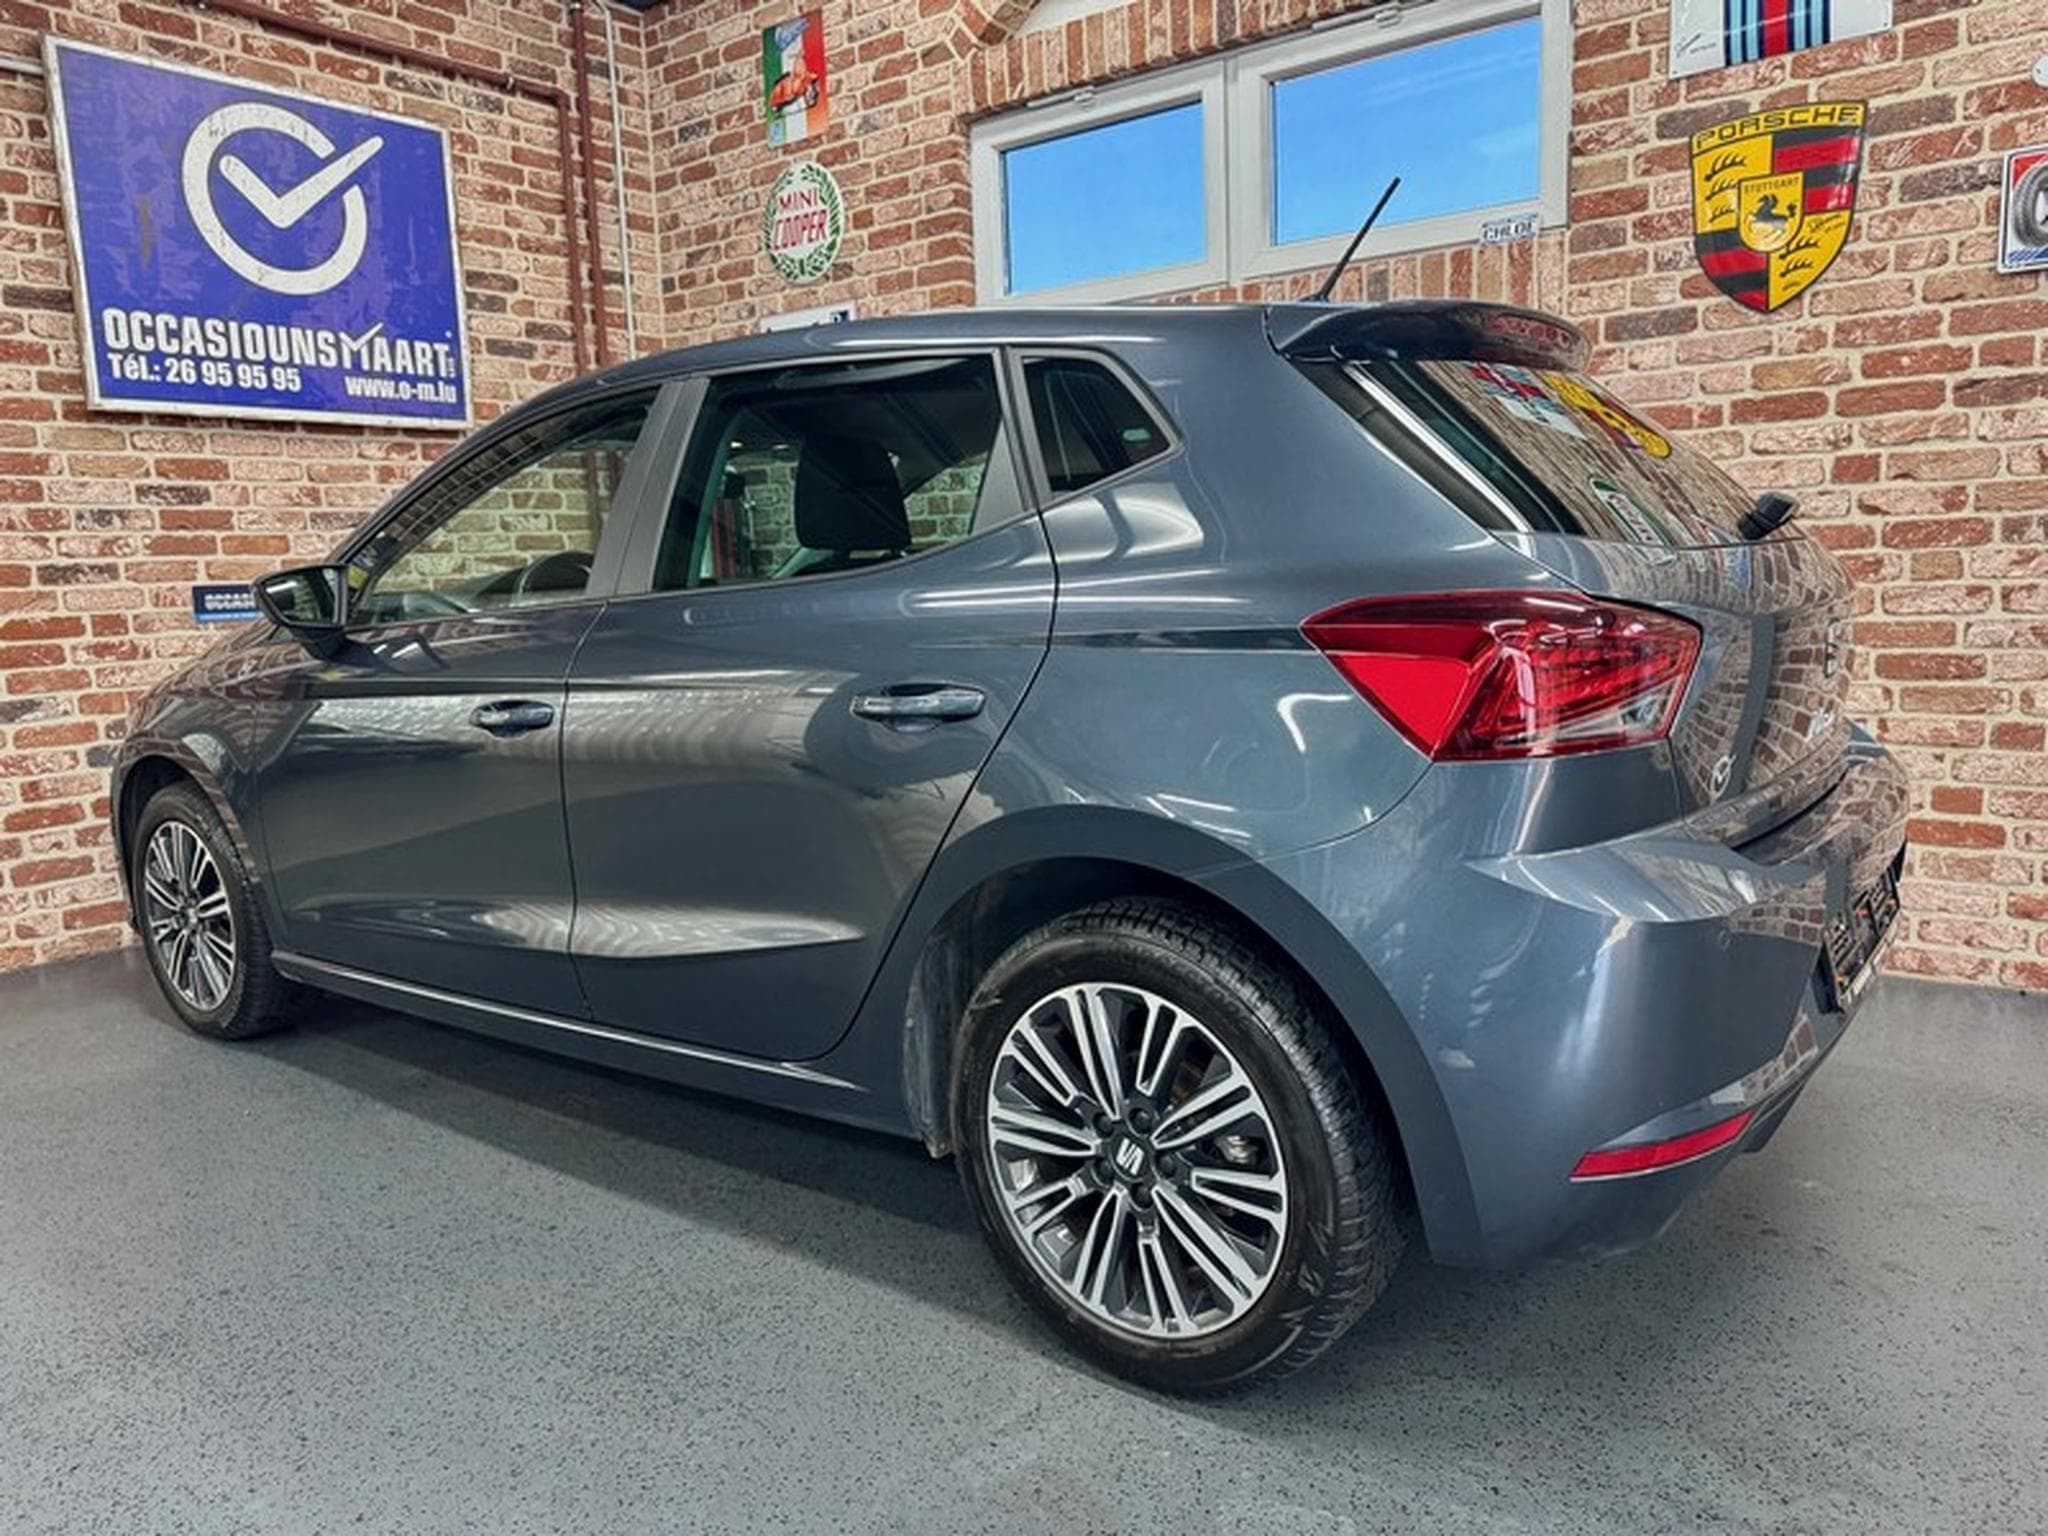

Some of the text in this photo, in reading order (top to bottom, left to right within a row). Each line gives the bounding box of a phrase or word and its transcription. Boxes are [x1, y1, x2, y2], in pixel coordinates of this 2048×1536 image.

[1696, 106, 1860, 149] PORSCHE
[780, 187, 818, 210] MINI
[1744, 176, 1800, 193] STUTTGART
[773, 209, 828, 250] COOPER
[102, 307, 450, 378] OCCASIOUNSMAART
[164, 357, 198, 385] 26
[201, 361, 233, 387] 95
[237, 363, 269, 390] 95
[272, 366, 302, 392] 95
[345, 376, 457, 404] www.o-m.lu
